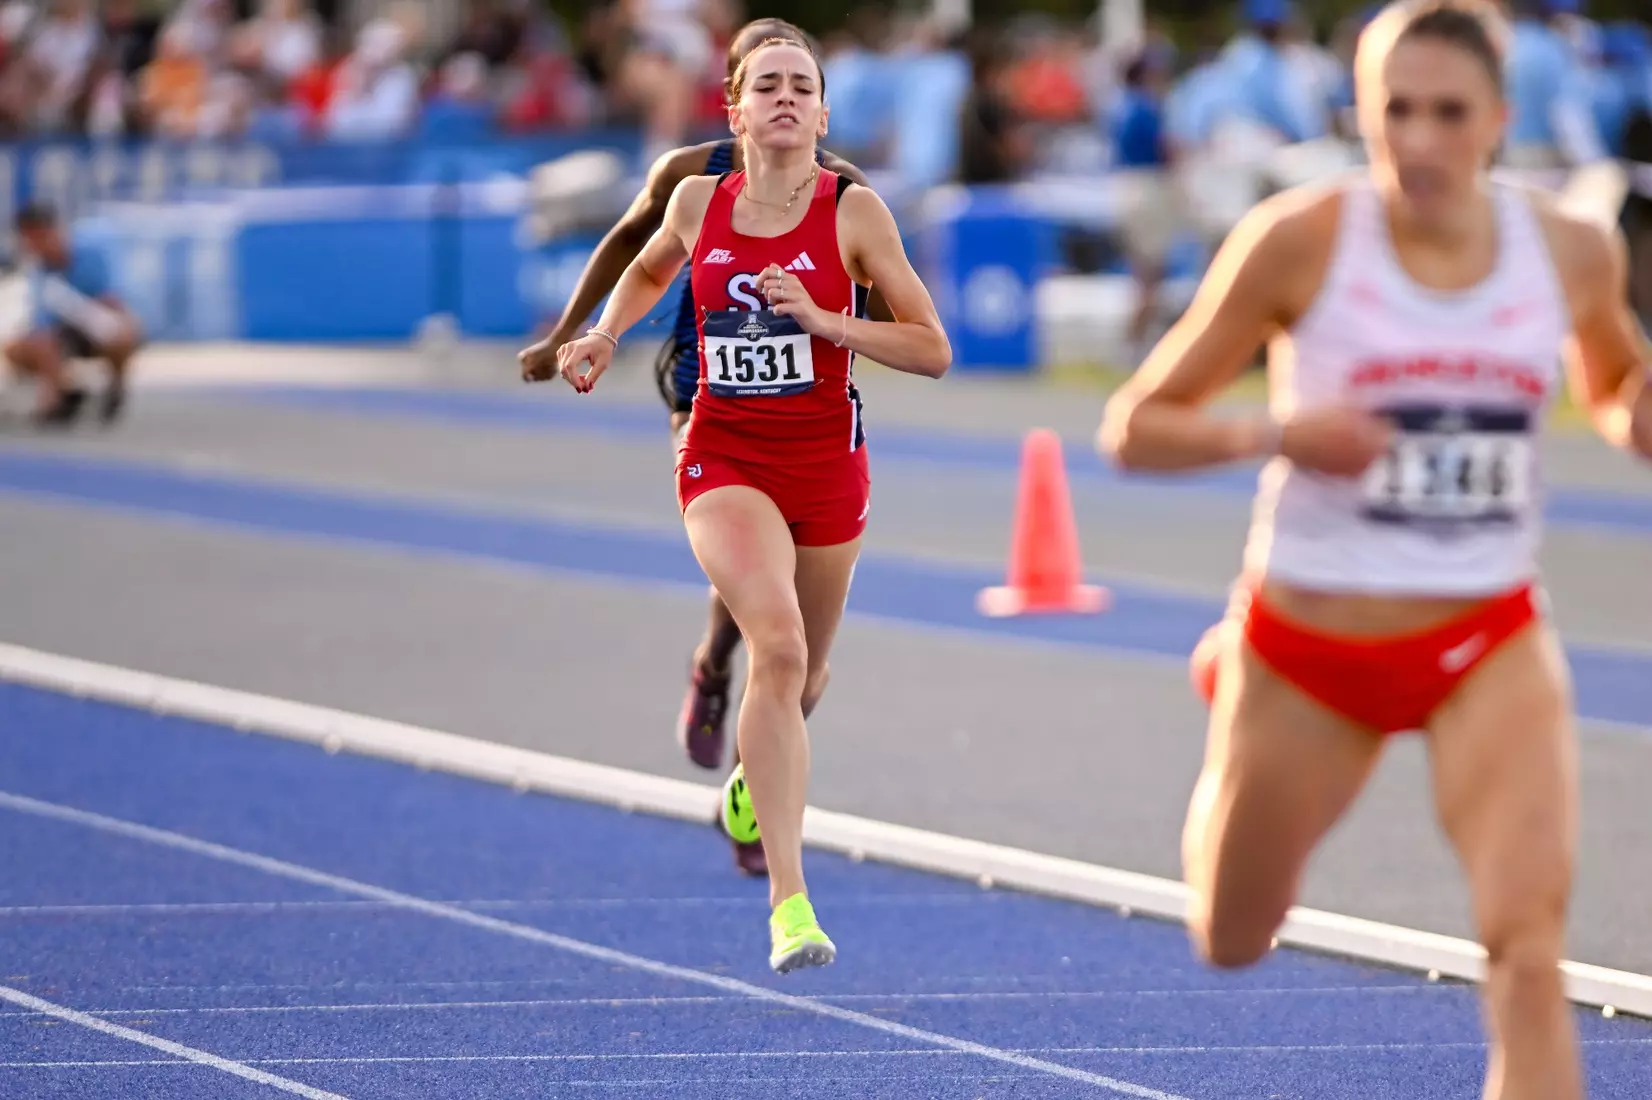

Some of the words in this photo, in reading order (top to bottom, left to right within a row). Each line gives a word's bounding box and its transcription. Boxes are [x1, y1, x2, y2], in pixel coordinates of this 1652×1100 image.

[709, 248, 731, 256] BIG
[704, 255, 736, 263] EAST
[716, 343, 801, 383] 1531
